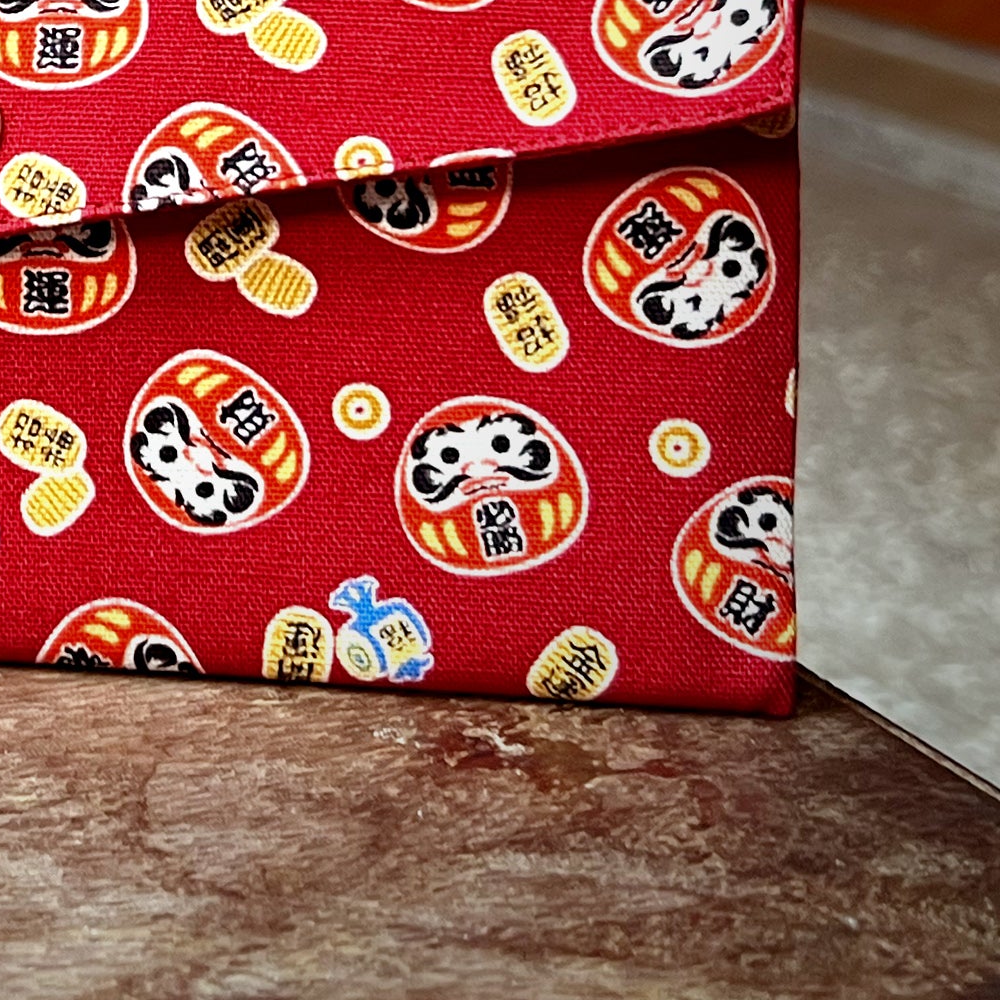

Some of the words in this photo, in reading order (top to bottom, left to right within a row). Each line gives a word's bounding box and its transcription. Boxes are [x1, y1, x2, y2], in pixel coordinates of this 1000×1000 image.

[36, 26, 82, 69] 運
[618, 201, 683, 260] 運
[23, 269, 70, 314] 運
[219, 389, 276, 445] 財
[719, 579, 776, 636] 財
